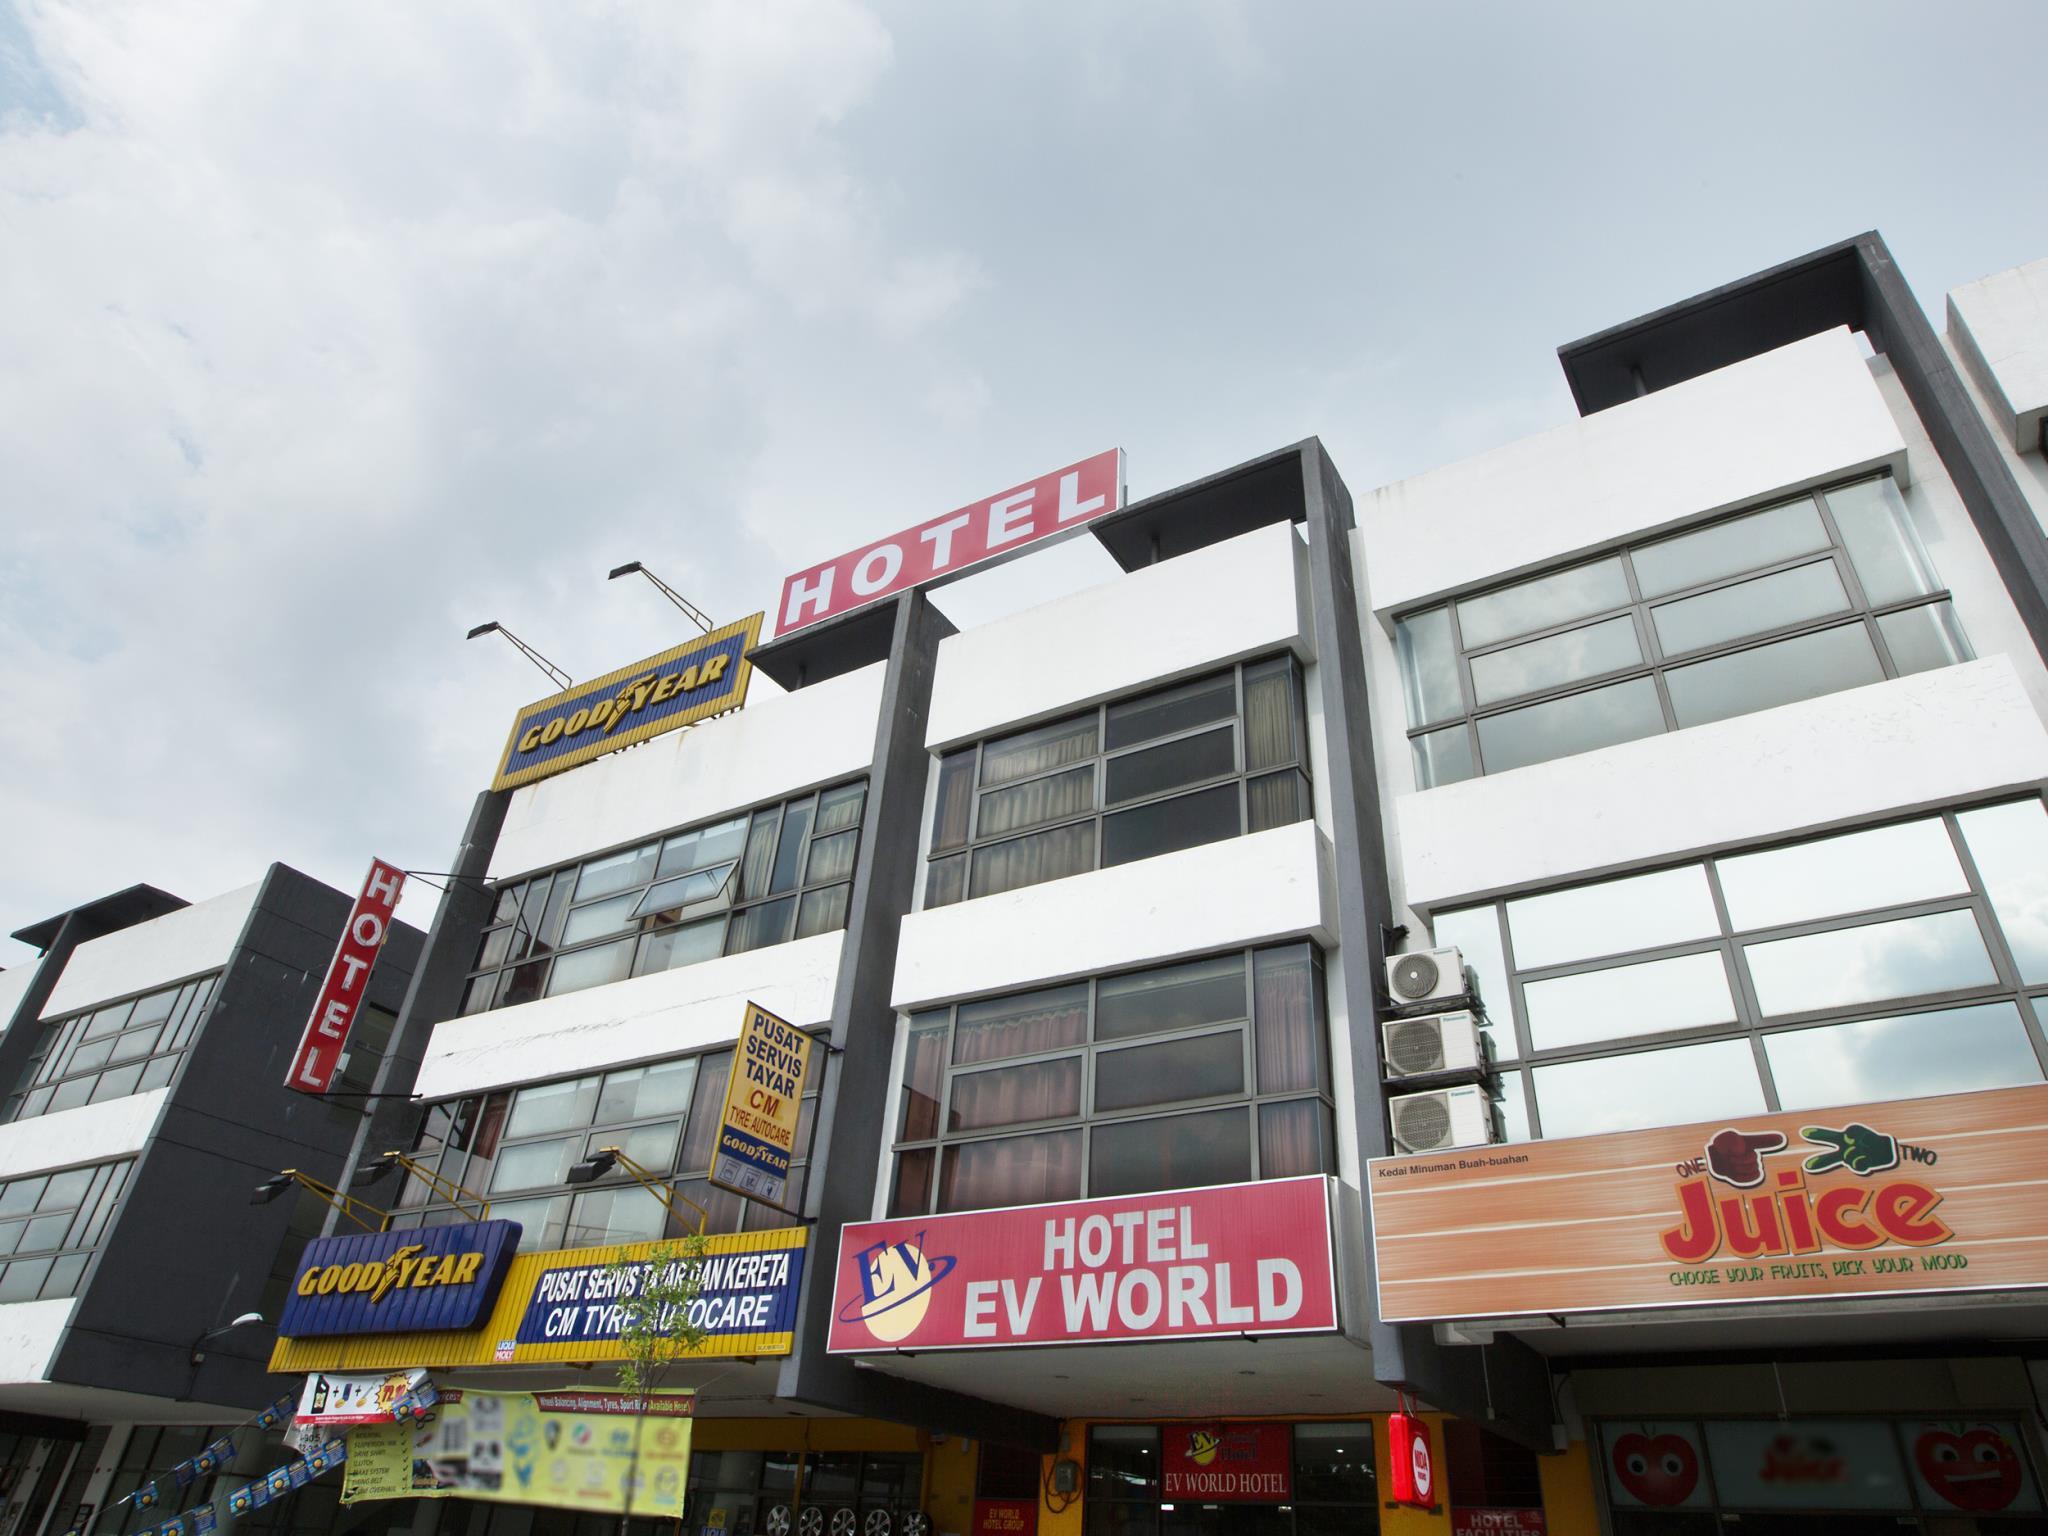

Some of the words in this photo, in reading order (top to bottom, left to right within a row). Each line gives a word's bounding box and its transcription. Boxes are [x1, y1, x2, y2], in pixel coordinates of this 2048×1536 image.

[784, 471, 1105, 627] HOTEL
[518, 652, 730, 753] GOODYEAR
[299, 867, 400, 1087] HOTEL
[753, 1013, 804, 1055] PUSAT
[746, 1034, 802, 1078] SERVIS
[746, 1058, 795, 1099] TAYAR
[729, 1106, 750, 1128] TYRE
[751, 1116, 791, 1147] AUTOCARE
[723, 1134, 788, 1170] GOODYEAR
[1378, 1166, 1407, 1177] Kedai
[1410, 1163, 1456, 1175] Minuman
[1459, 1154, 1529, 1170] Buah-buahan
[1676, 1157, 1707, 1178] ONE
[1900, 1144, 1937, 1167] TWO
[1662, 1169, 1953, 1263] Juice
[1042, 1206, 1208, 1271] HOTEL
[297, 1244, 485, 1303] GOODYEAR
[537, 1270, 588, 1303] PUSAT
[584, 1266, 640, 1299] SERVIS
[722, 1253, 789, 1289] KERETA
[1669, 1269, 1721, 1286] CHOOSE
[1726, 1266, 1764, 1283] YOUR
[1771, 1262, 1828, 1280] FRUITS,
[1874, 1256, 1914, 1273] YOUR
[1921, 1254, 1968, 1271] MOOD
[962, 1277, 1043, 1338] EV
[1060, 1257, 1304, 1334] WORLD
[545, 1307, 579, 1337] CM
[1165, 1473, 1183, 1491] EV
[1186, 1473, 1236, 1492] WORLD
[1240, 1473, 1287, 1493] HOTEL
[983, 1519, 1002, 1530] HOTEL
[1471, 1515, 1524, 1528] HOTEL
